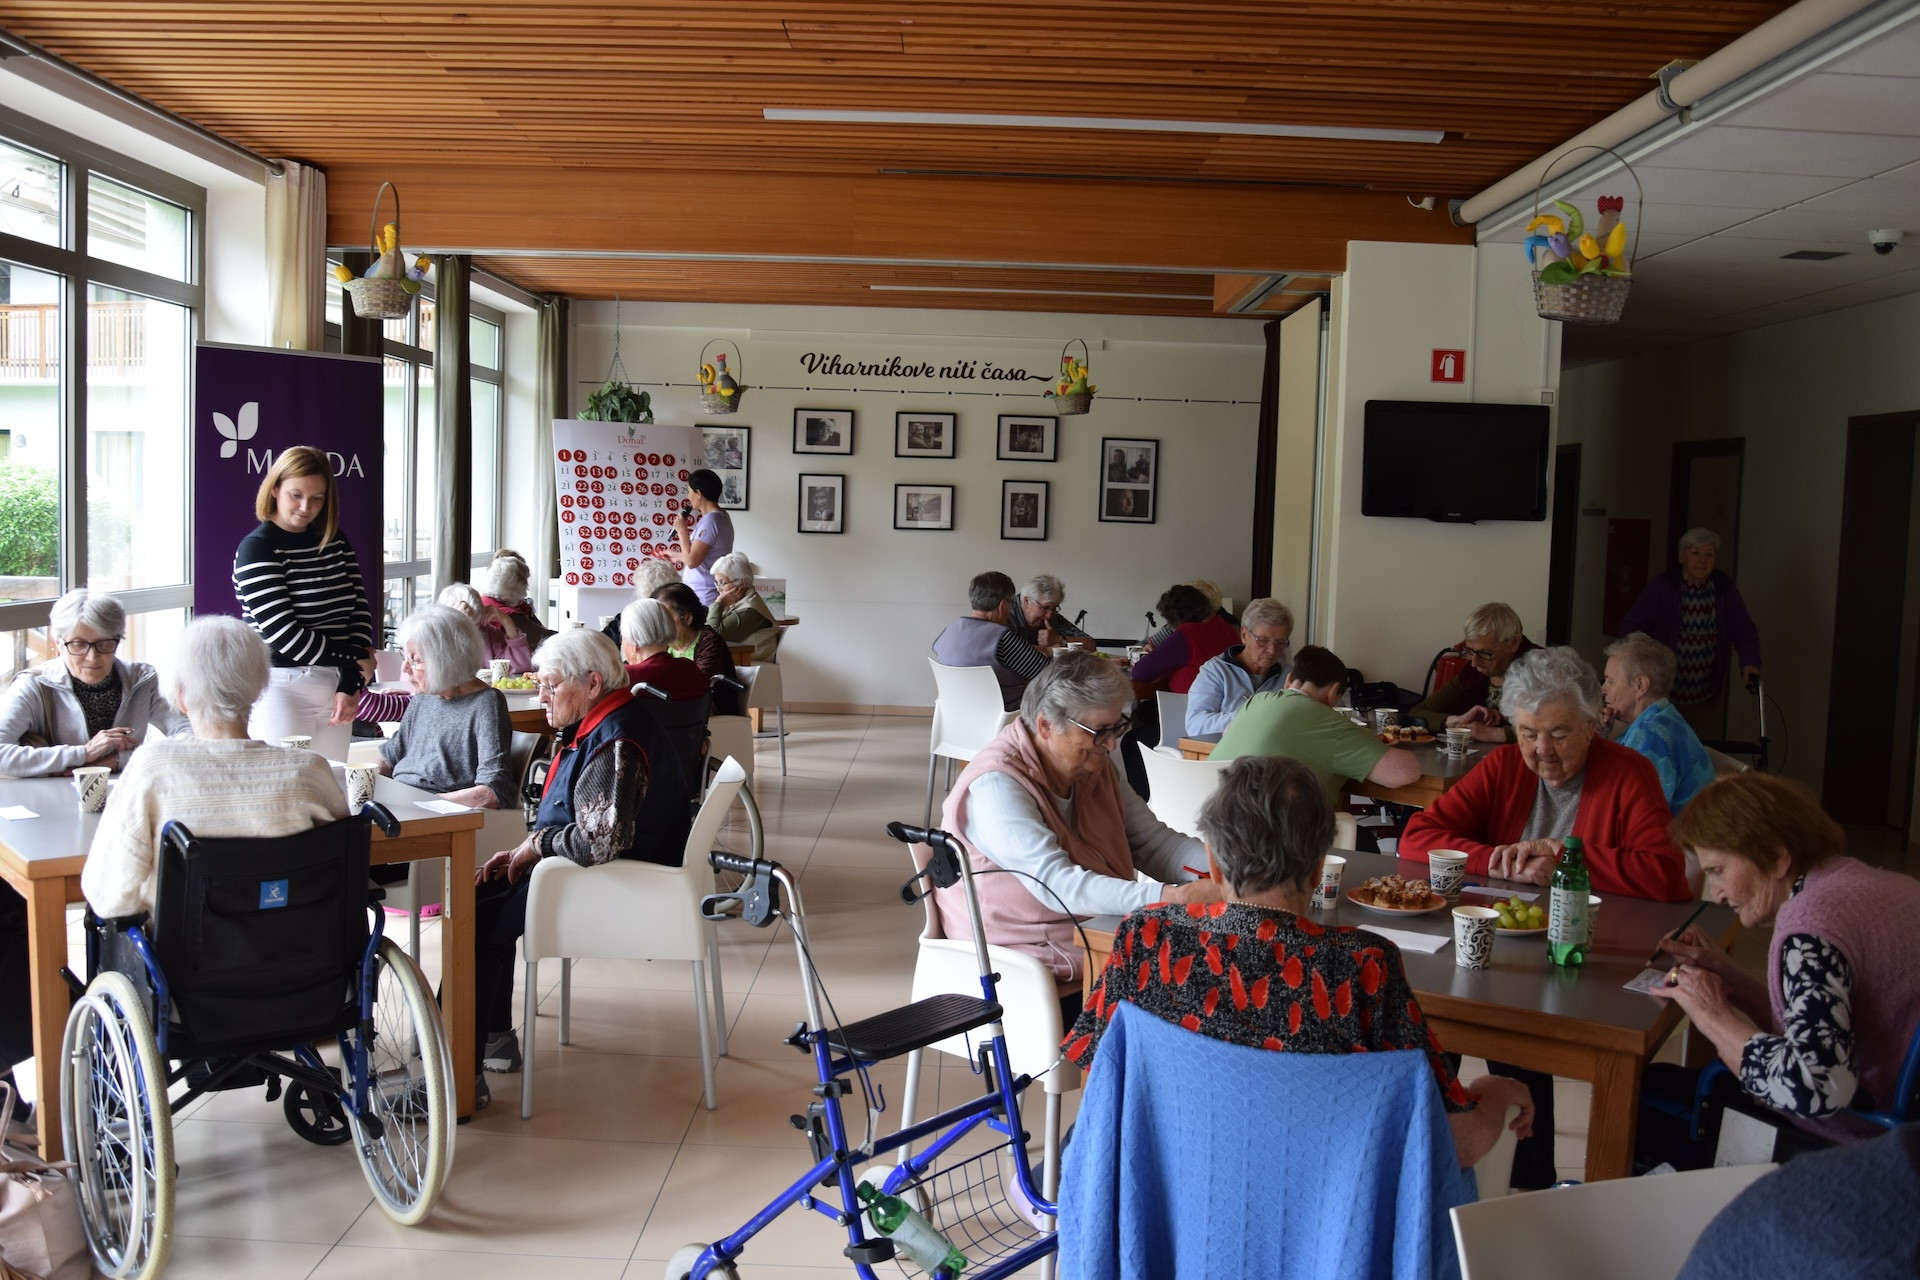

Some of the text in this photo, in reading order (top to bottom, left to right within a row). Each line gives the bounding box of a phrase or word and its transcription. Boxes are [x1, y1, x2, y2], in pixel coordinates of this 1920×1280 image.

[800, 352, 1054, 381] Viharnikove niti časa
[247, 448, 365, 478] MDA
[667, 486, 676, 494] 28
[562, 497, 571, 505] 31
[578, 498, 588, 506] 32
[594, 498, 603, 506] 33
[653, 500, 662, 508] 37
[668, 501, 677, 509] 38
[640, 515, 648, 523] 46
[656, 530, 664, 538] 57
[596, 544, 606, 552] 63
[1550, 891, 1562, 939] Donat
